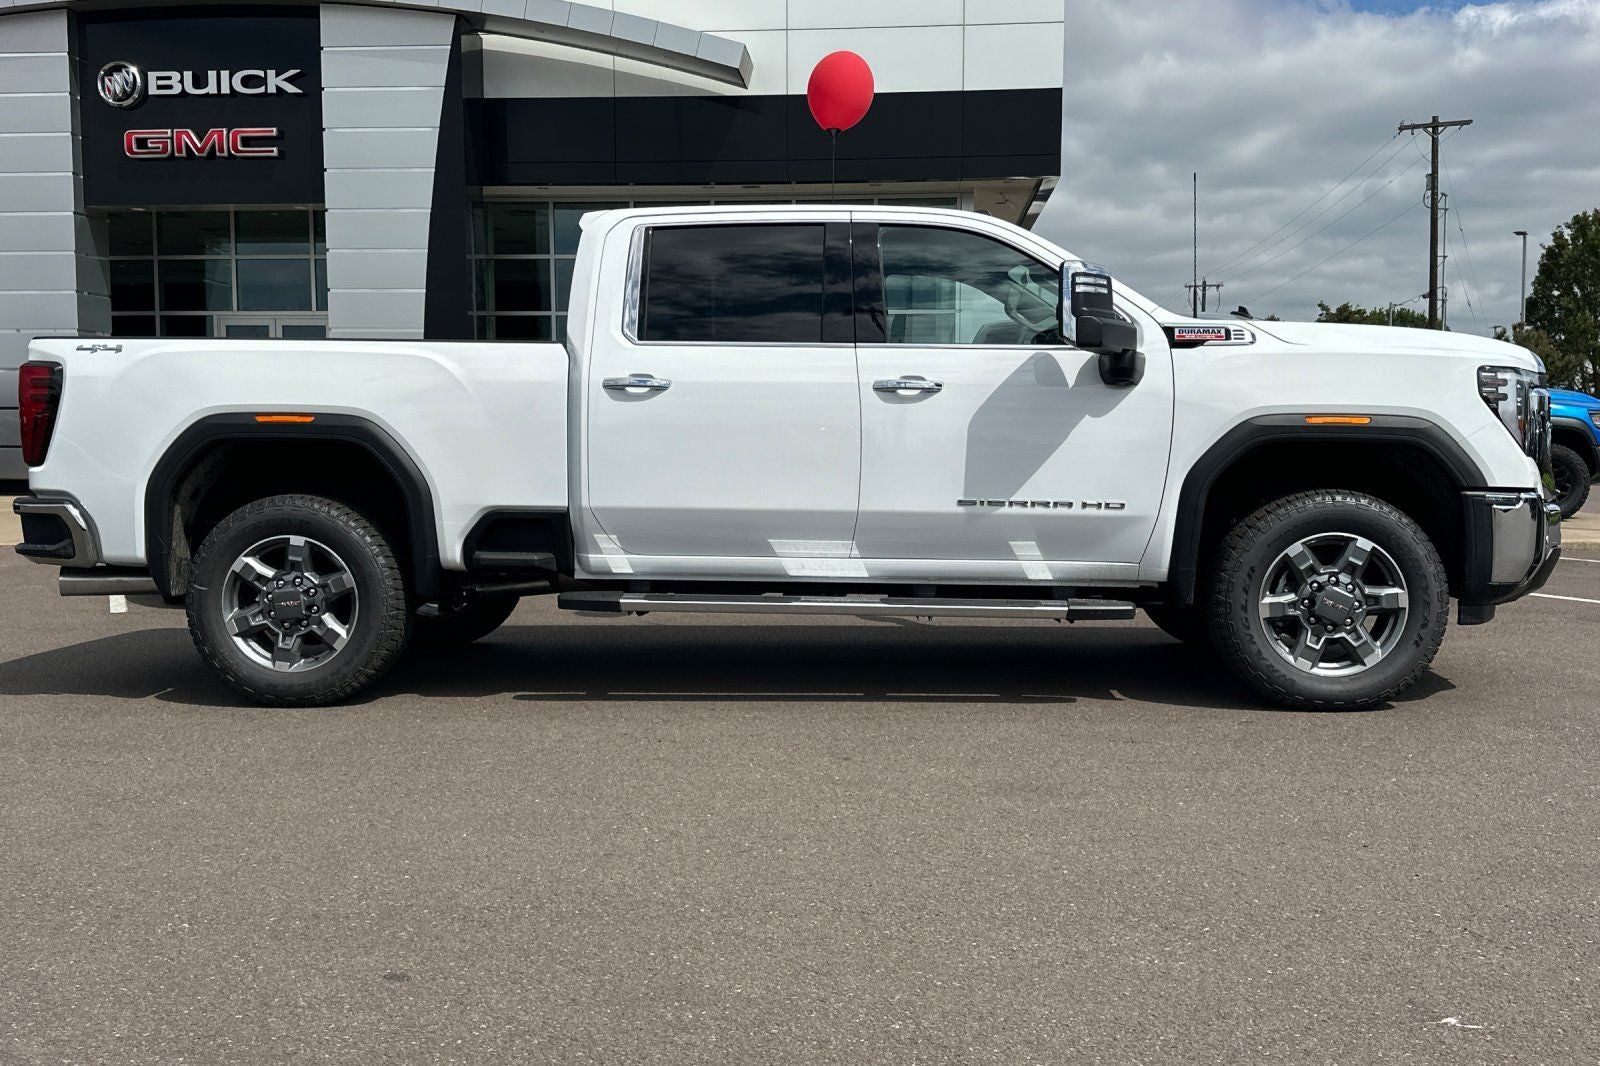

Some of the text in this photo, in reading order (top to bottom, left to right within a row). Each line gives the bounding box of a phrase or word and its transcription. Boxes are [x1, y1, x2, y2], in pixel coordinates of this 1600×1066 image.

[147, 69, 304, 95] BUICK
[123, 127, 280, 159] GMC
[957, 499, 1126, 510] SIERRA HD
